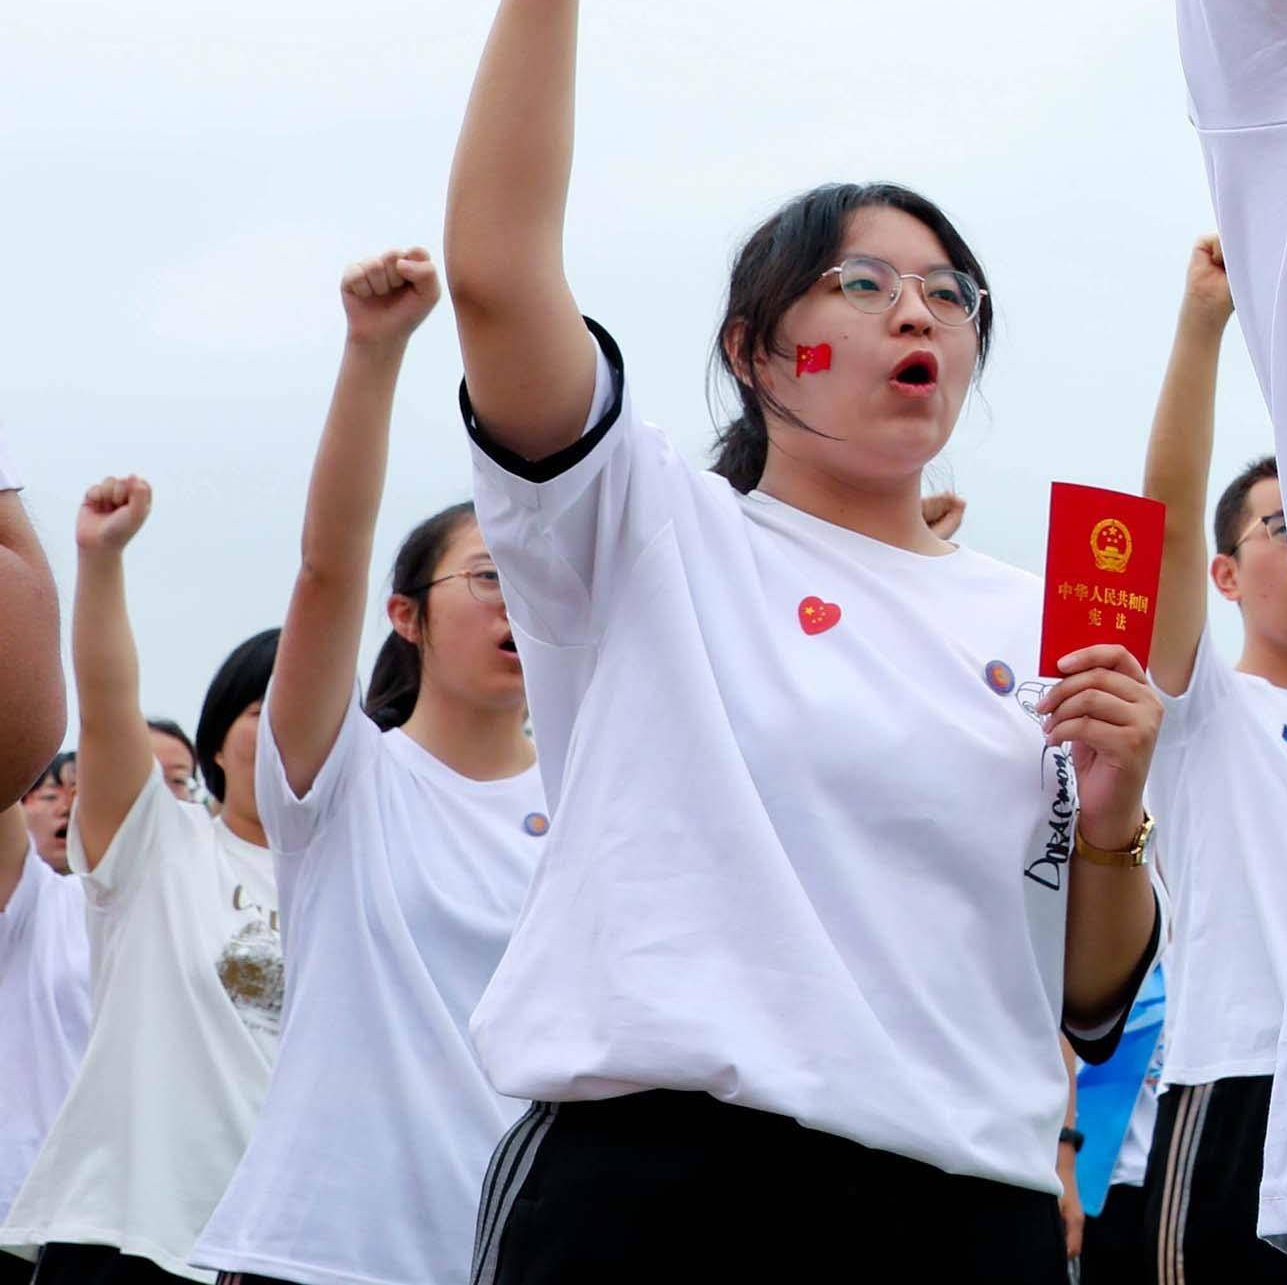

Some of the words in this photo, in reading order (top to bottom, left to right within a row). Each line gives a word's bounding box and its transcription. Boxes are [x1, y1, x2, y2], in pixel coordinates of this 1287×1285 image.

[1057, 580, 1149, 615] 中华人民共和国
[1088, 607, 1128, 632] 宪法
